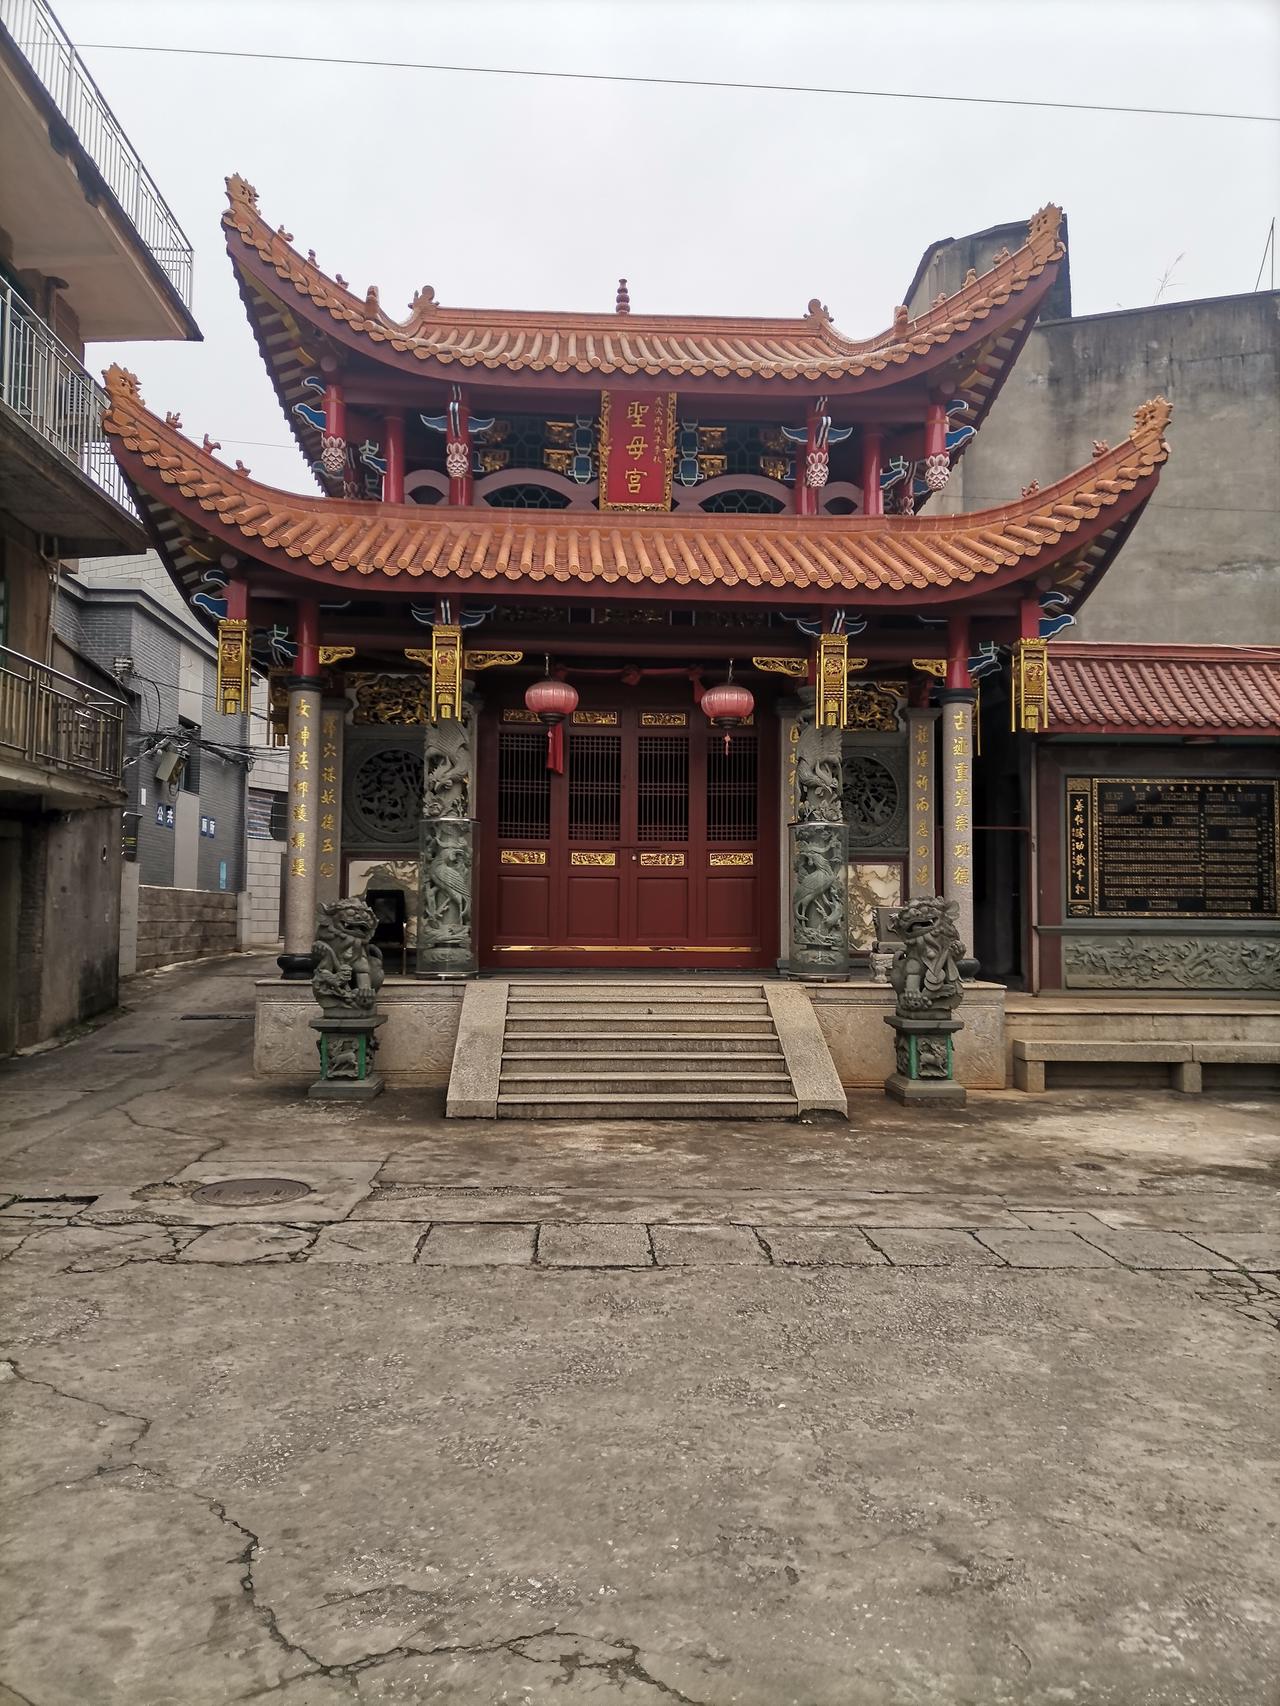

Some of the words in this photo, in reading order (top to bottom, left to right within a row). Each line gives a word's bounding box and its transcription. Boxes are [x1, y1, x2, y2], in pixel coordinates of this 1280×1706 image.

[625, 401, 650, 494] 聖母宮
[157, 805, 174, 824] 公共
